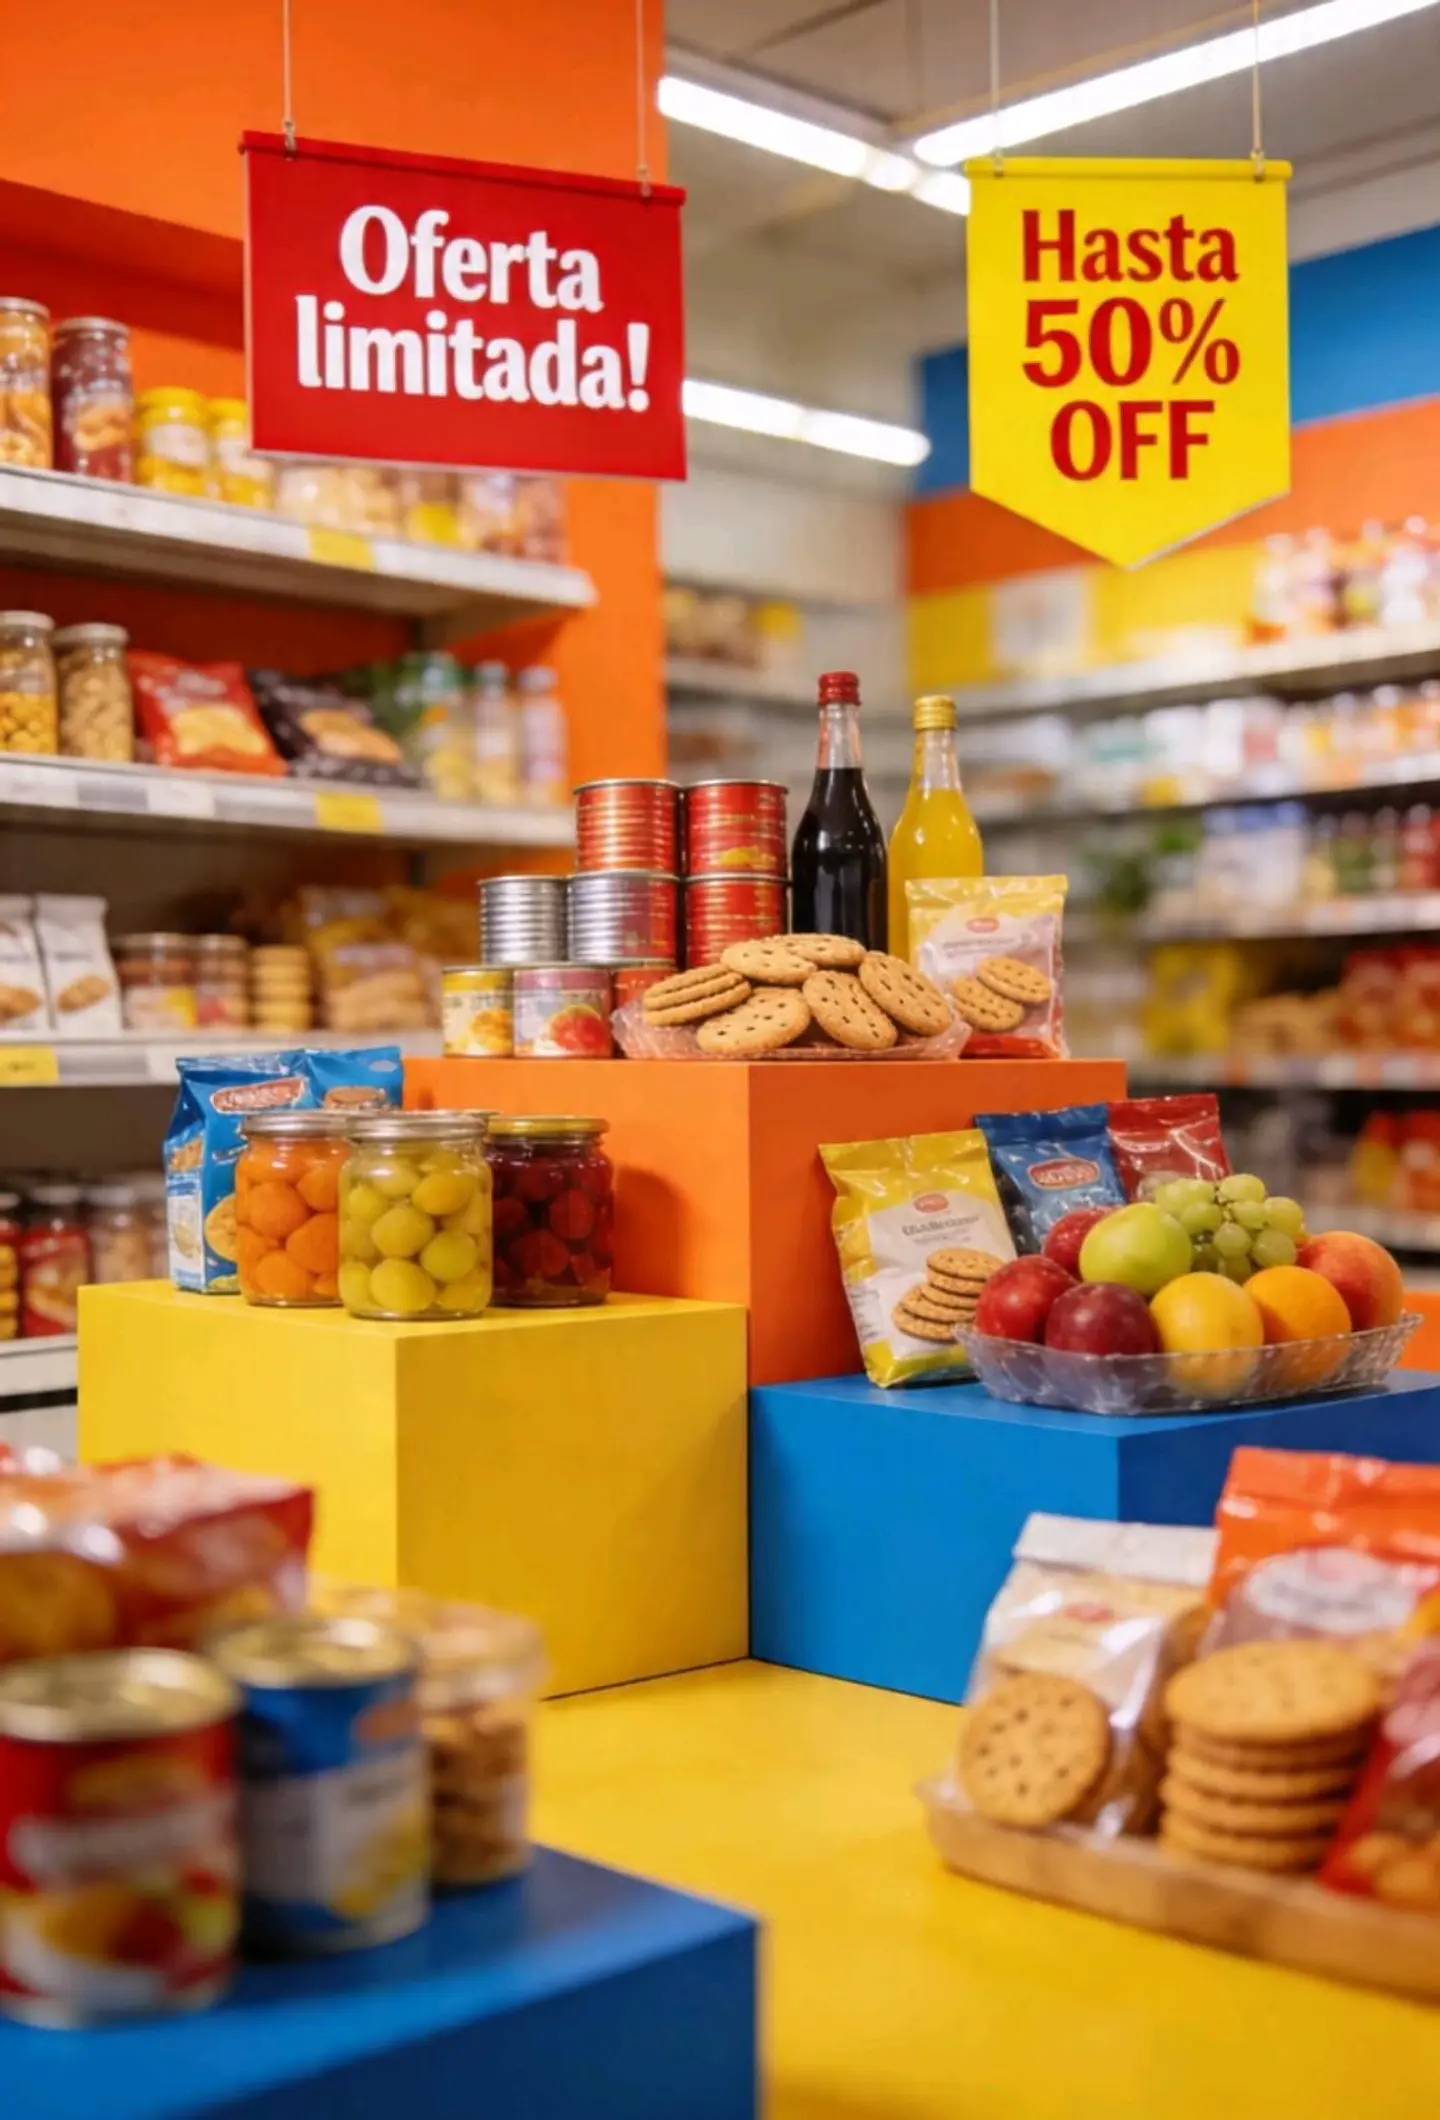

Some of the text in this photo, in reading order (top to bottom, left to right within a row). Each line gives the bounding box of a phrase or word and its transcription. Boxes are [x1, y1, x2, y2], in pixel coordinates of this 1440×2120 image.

[339, 205, 604, 313] Oferta
[1022, 209, 1240, 283] Hasta
[295, 294, 650, 413] limitada!
[1022, 296, 1241, 389] 50%
[1050, 400, 1215, 481] OFF
